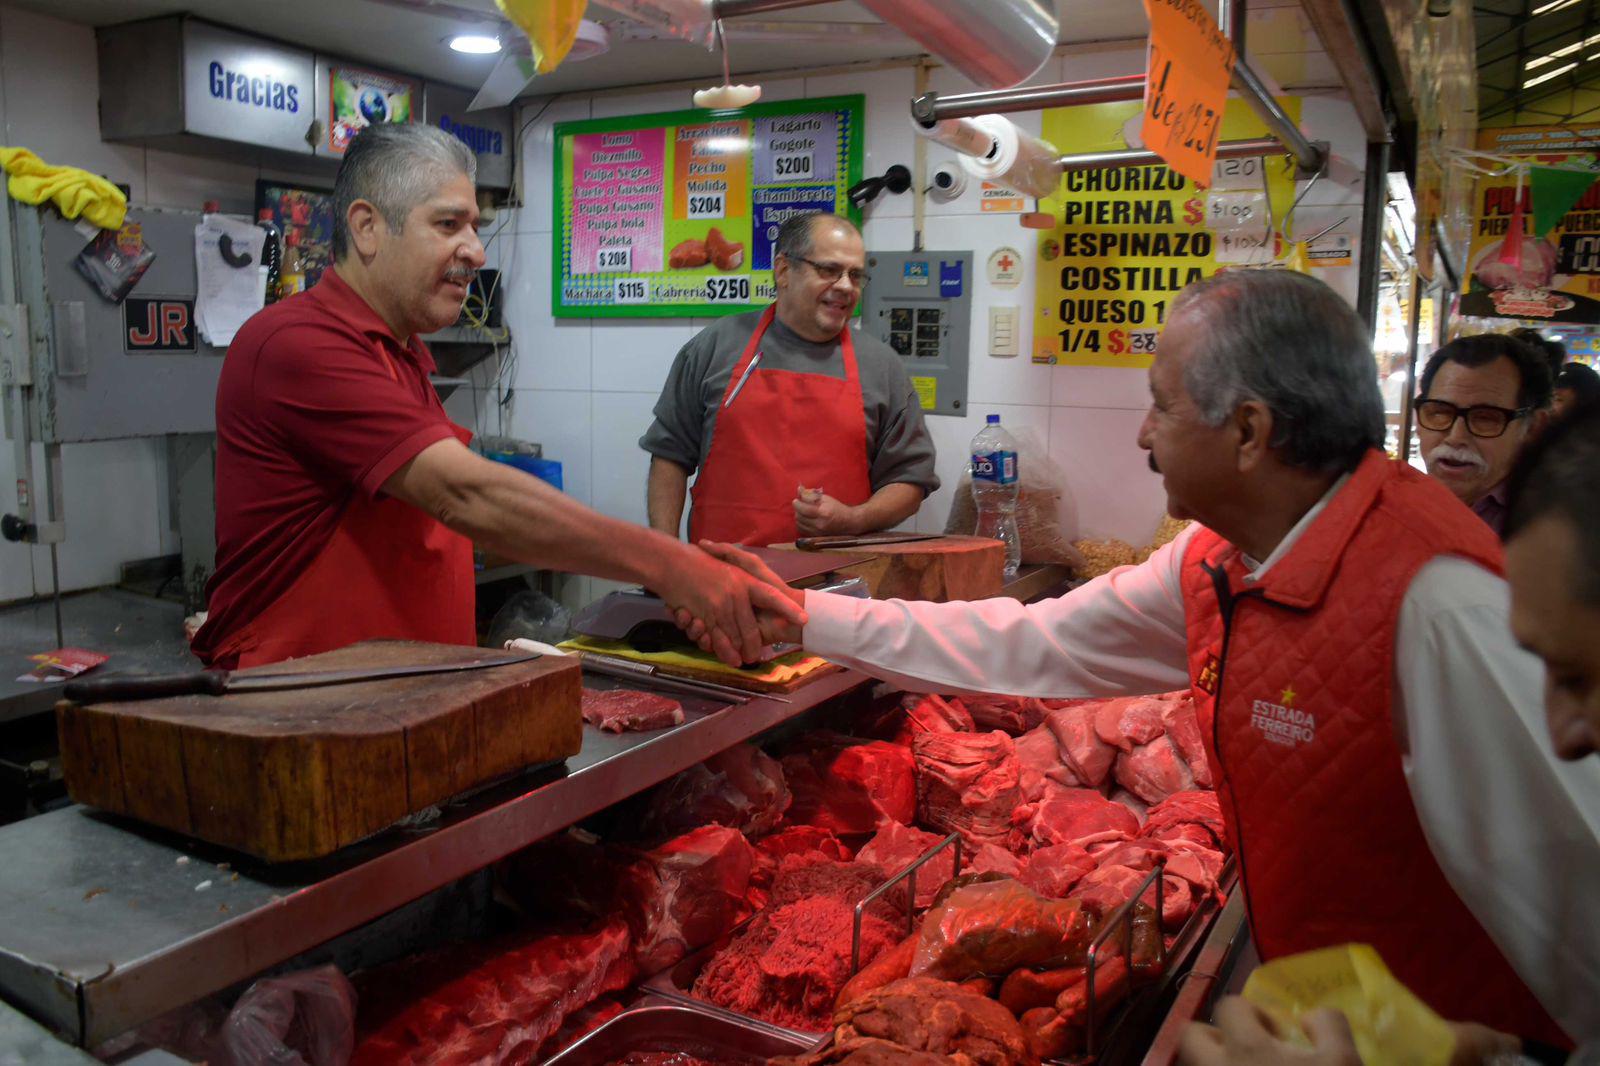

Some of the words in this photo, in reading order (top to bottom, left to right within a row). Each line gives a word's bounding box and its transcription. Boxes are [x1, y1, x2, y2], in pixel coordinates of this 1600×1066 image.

[209, 61, 299, 113] Gracias
[770, 119, 821, 134] Lagarto
[688, 162, 727, 175] Pecho
[776, 156, 810, 175] $200
[1217, 159, 1256, 178] 120
[583, 169, 615, 182] Pulpa
[1067, 166, 1185, 192] CHORIZO
[686, 180, 728, 192] Molida
[579, 203, 610, 216] Pulpa
[689, 197, 722, 214] $204
[1065, 200, 1174, 224] PIERNA
[1183, 198, 1204, 226] $
[587, 219, 618, 231] Pulpa
[599, 235, 633, 246] Paleta
[1064, 231, 1211, 257] ESPINAZO
[1061, 266, 1202, 291] COSTILLA
[565, 288, 613, 300] Machaca
[618, 282, 645, 299] $115
[707, 278, 750, 301] $250
[1059, 298, 1145, 325] QUESO
[129, 301, 188, 346] JR
[1058, 328, 1101, 352] 1/4
[1107, 328, 1125, 355] $
[1131, 332, 1157, 352] 38
[1252, 699, 1315, 729] ESTRADA
[1251, 713, 1314, 743] FERREIRO
